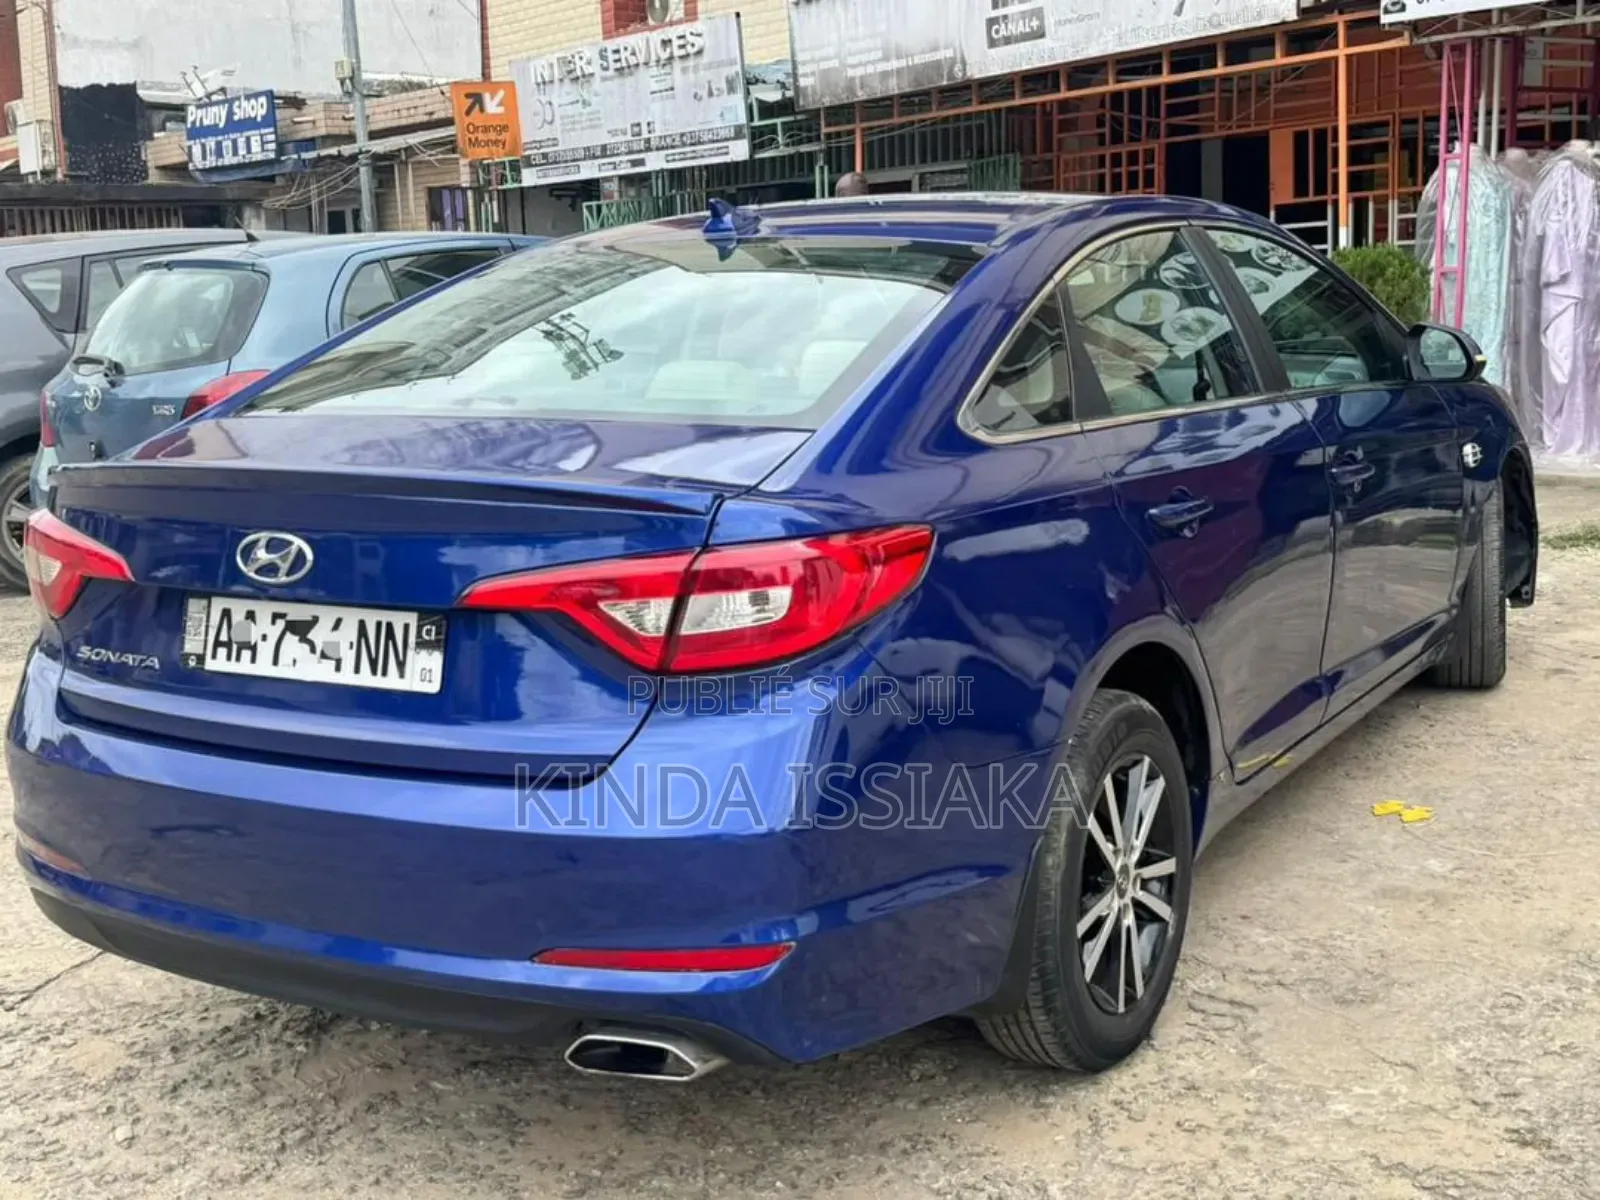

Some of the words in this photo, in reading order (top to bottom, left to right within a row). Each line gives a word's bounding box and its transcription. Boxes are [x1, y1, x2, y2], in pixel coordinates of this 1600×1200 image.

[991, 15, 1040, 39] CANAL+
[599, 30, 705, 73] SERVICES
[187, 103, 229, 129] Pruny
[233, 95, 267, 122] shop
[466, 122, 509, 136] Orange
[467, 137, 506, 150] Money
[76, 645, 160, 669] SONATA
[420, 667, 433, 683] 01
